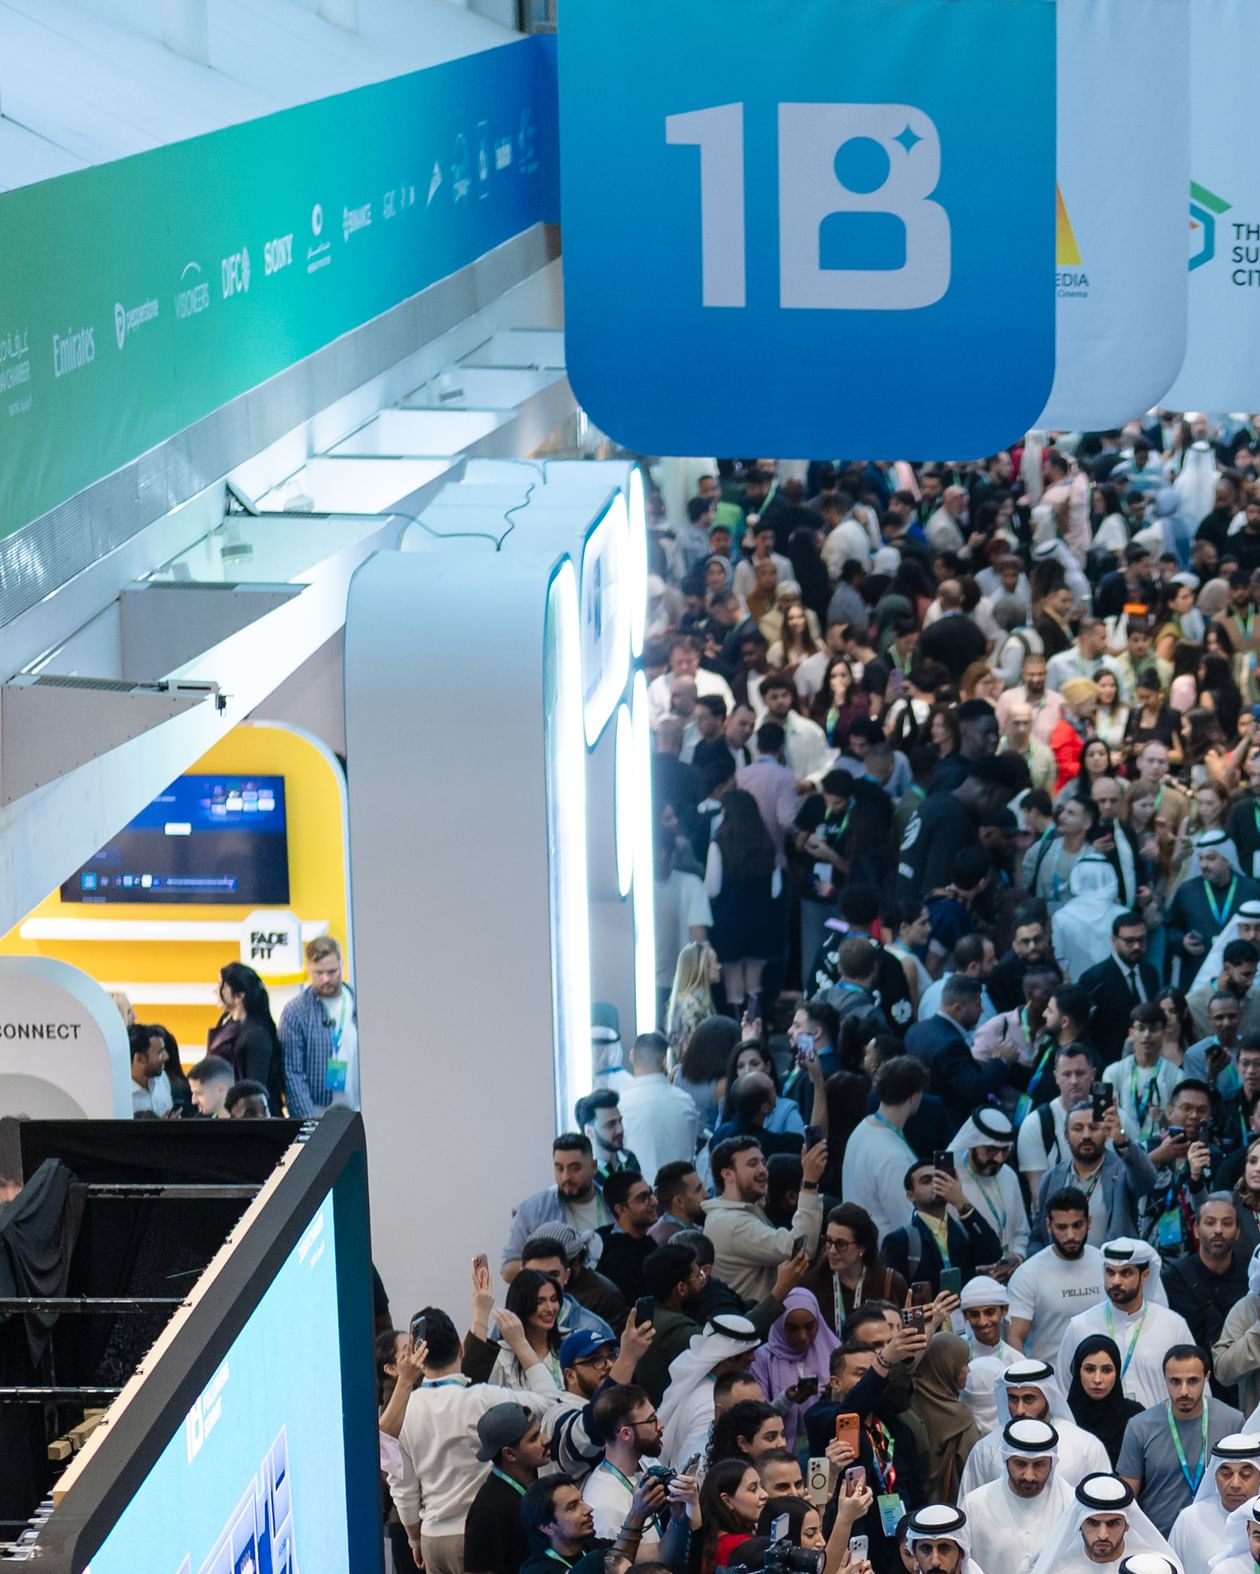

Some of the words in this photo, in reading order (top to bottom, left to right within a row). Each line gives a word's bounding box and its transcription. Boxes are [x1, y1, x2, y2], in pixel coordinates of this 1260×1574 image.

[665, 102, 952, 311] 1B
[264, 233, 294, 276] SONY
[52, 325, 96, 379] Emirates
[251, 932, 289, 945] FADE
[251, 947, 273, 960] FIT
[0, 1023, 81, 1040] ONNECT
